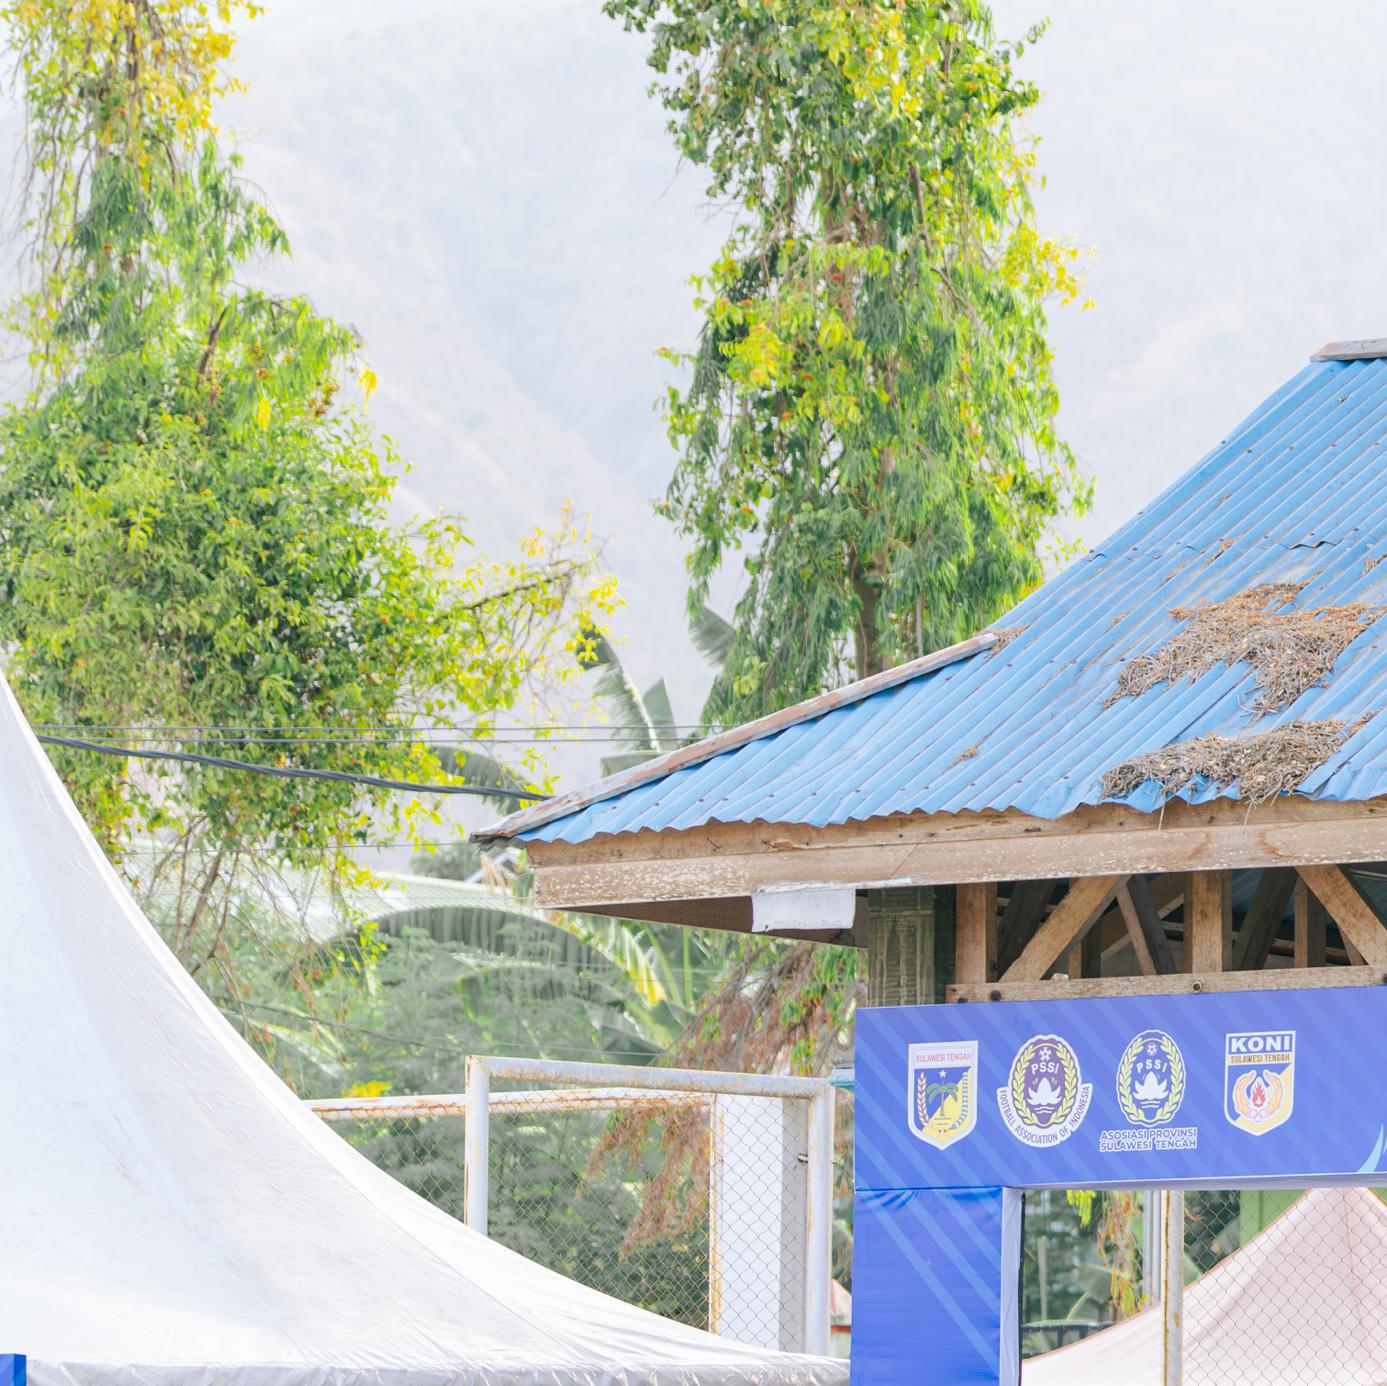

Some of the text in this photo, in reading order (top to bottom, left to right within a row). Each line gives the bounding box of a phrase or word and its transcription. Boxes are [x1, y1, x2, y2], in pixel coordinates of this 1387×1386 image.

[1231, 1035, 1291, 1053] KONI
[915, 1052, 971, 1063] SULAWESI TENGAH
[1230, 1053, 1290, 1064] SULAWESI TENGAH
[1031, 1062, 1060, 1075] PSSI
[1136, 1059, 1168, 1074] PSSI
[999, 1086, 1091, 1145] FOOTBALL ASSOCIATION OF INDONESIA
[1101, 1128, 1197, 1141] ASOSIASI PROVINSI
[1100, 1139, 1196, 1151] SULAWESI TENGAH
